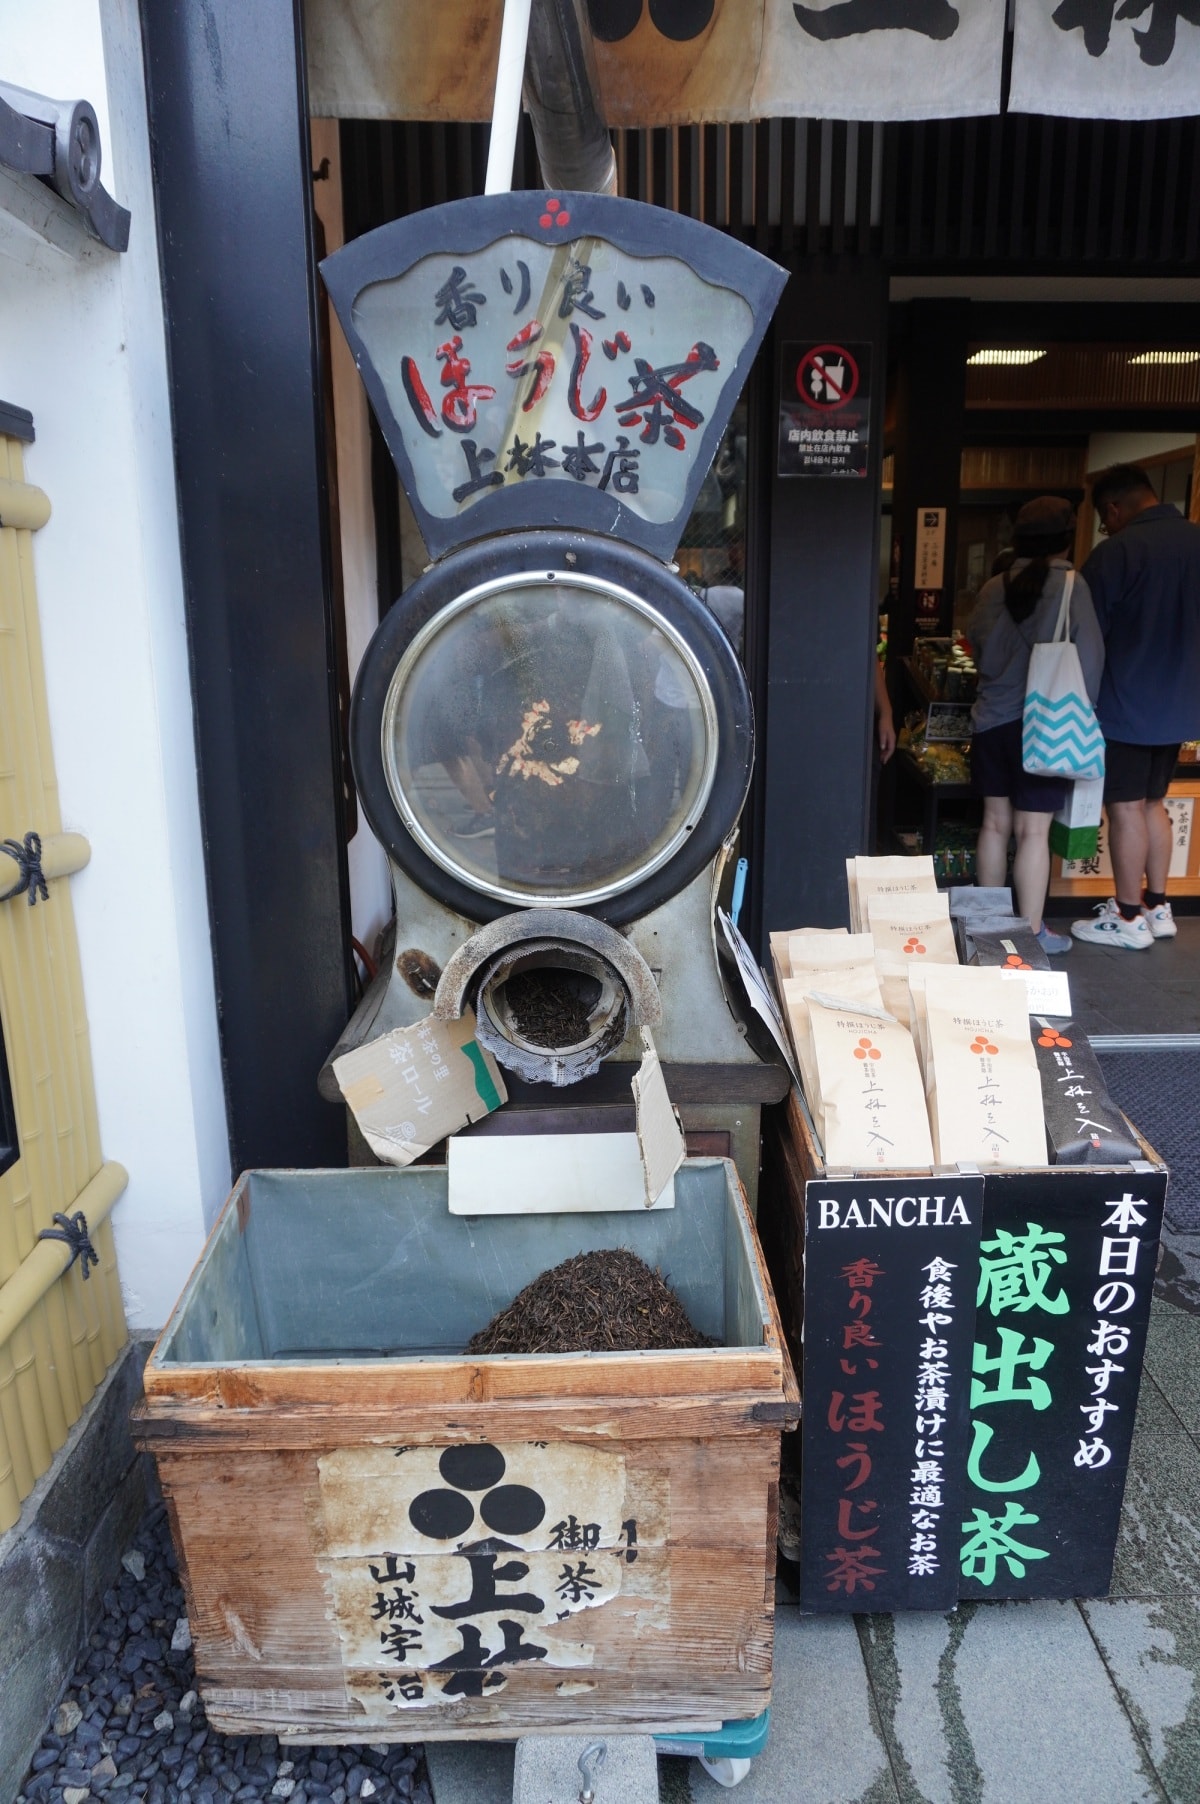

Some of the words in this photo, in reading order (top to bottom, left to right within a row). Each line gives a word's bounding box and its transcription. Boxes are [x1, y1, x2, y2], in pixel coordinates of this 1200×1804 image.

[435, 260, 655, 331] 香り良い
[401, 319, 720, 451] ほうじ茶
[788, 429, 859, 442] 店内飲食禁止
[452, 430, 641, 502] 上林本店
[818, 1195, 972, 1230] BANCHA
[1073, 1192, 1149, 1470] 本日のおすすめ
[826, 1257, 888, 1596] 香り良いほうじ茶
[906, 1255, 959, 1577] 食後やお茶漬けに最適なお茶
[960, 1222, 1071, 1587] 蔵出し茶
[367, 1556, 425, 1701] 山城宇治
